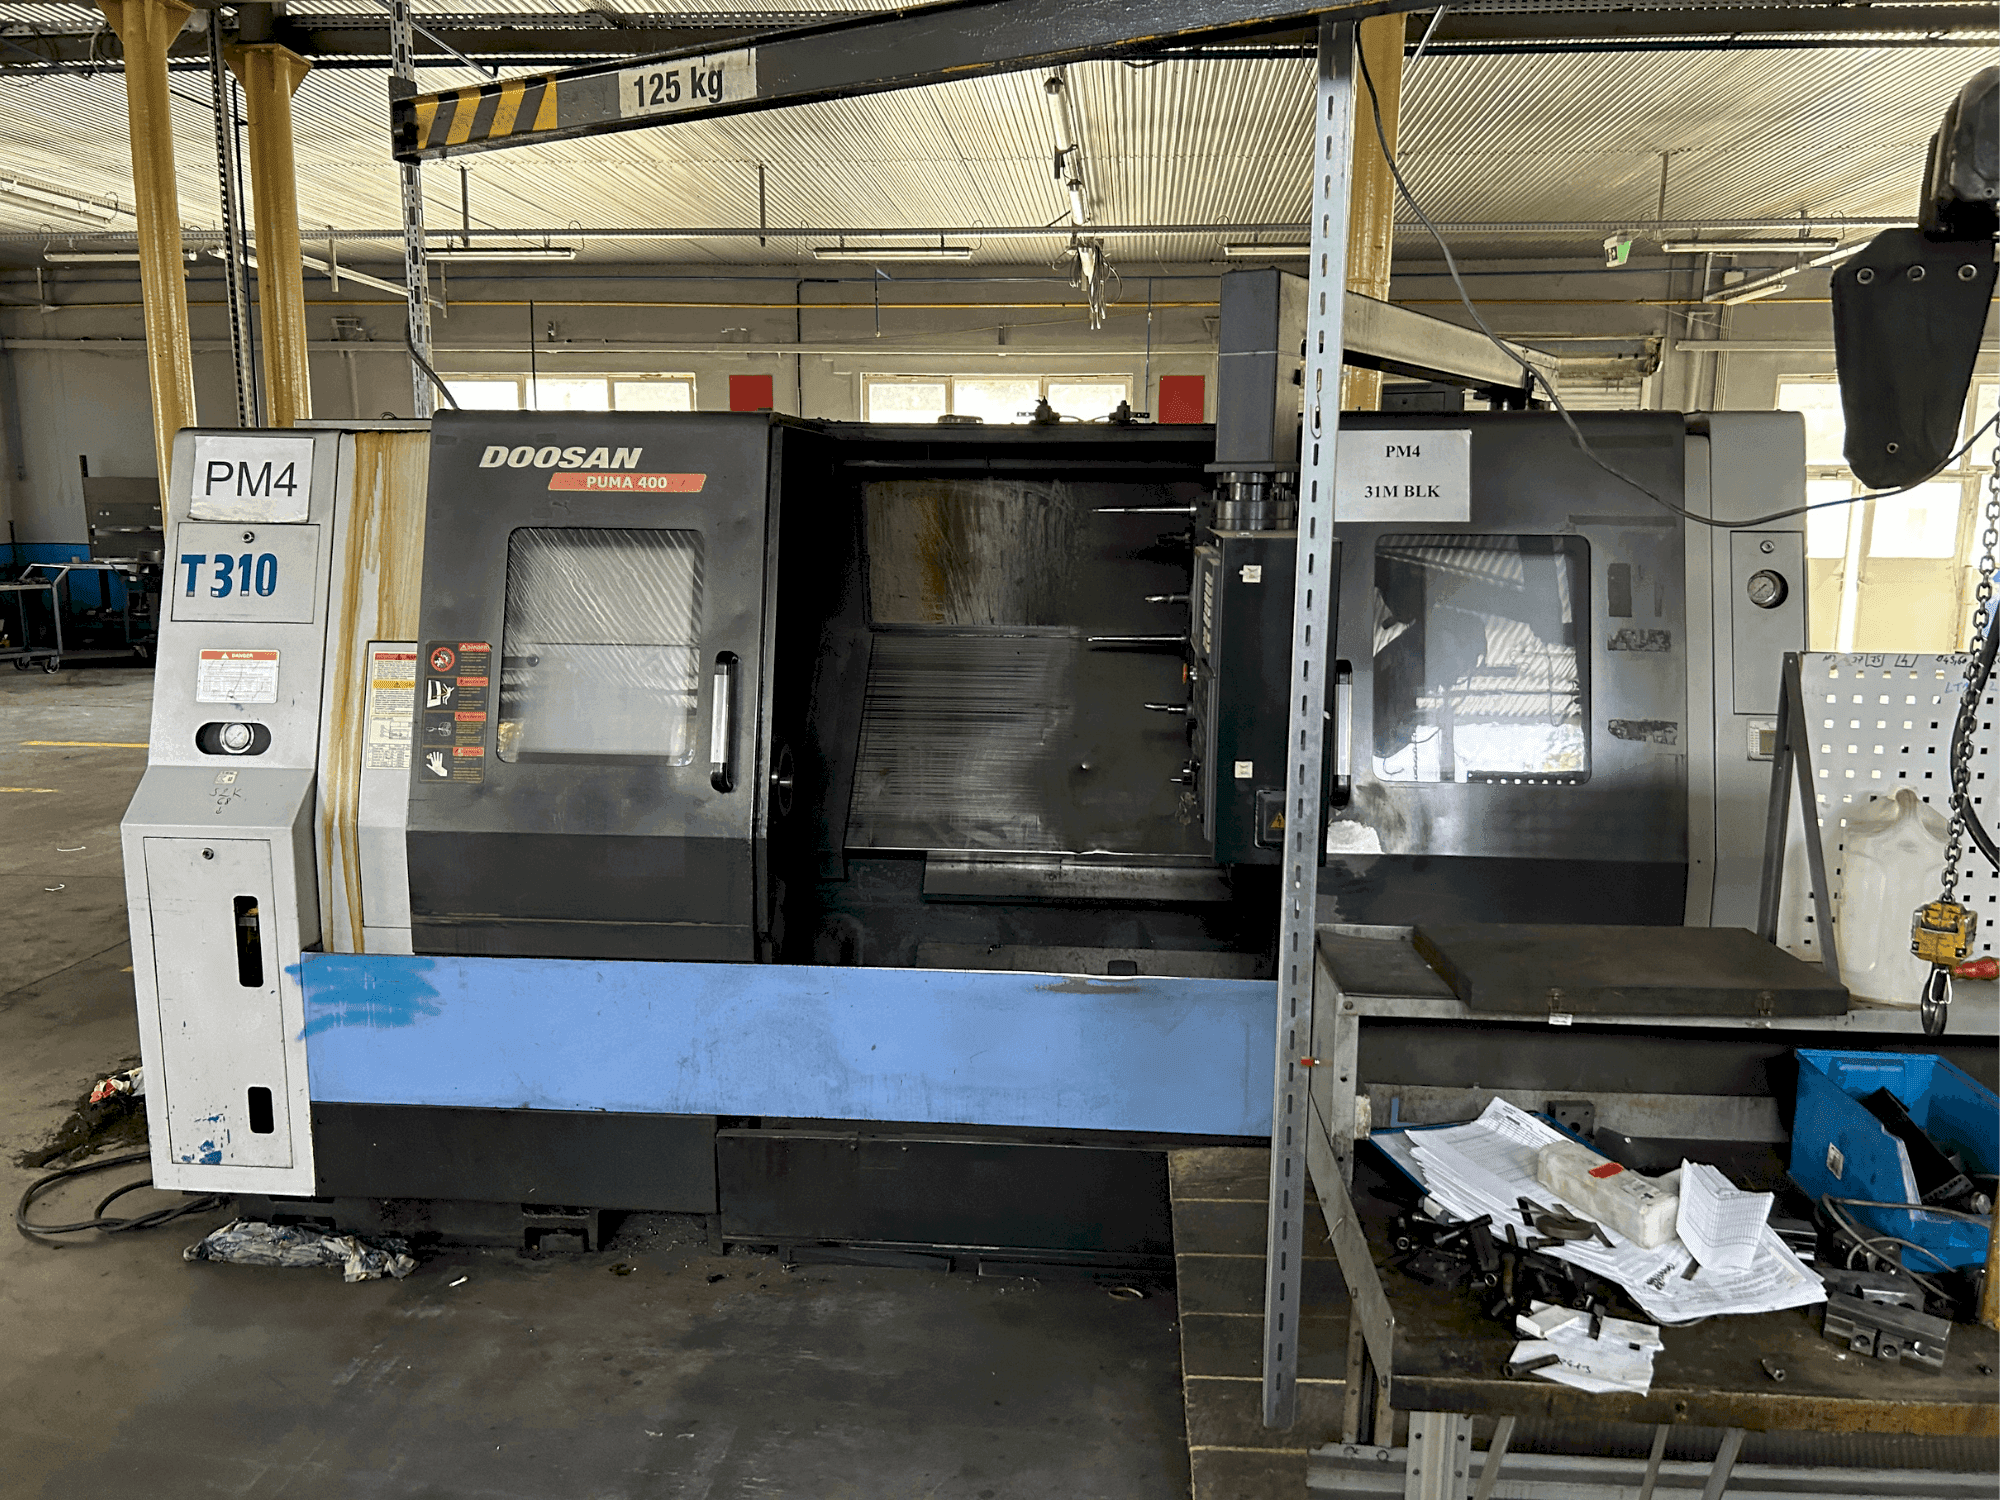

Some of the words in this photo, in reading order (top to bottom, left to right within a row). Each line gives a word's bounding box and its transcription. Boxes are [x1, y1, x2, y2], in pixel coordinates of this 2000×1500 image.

[633, 70, 681, 108] 125
[690, 66, 723, 103] kg
[478, 445, 643, 469] DOOSAN
[1386, 445, 1421, 458] PM4
[205, 459, 298, 498] PM4
[586, 476, 634, 489] PUMA
[637, 476, 669, 489] 400
[1365, 485, 1400, 498] 31M
[1404, 485, 1441, 498] BLK
